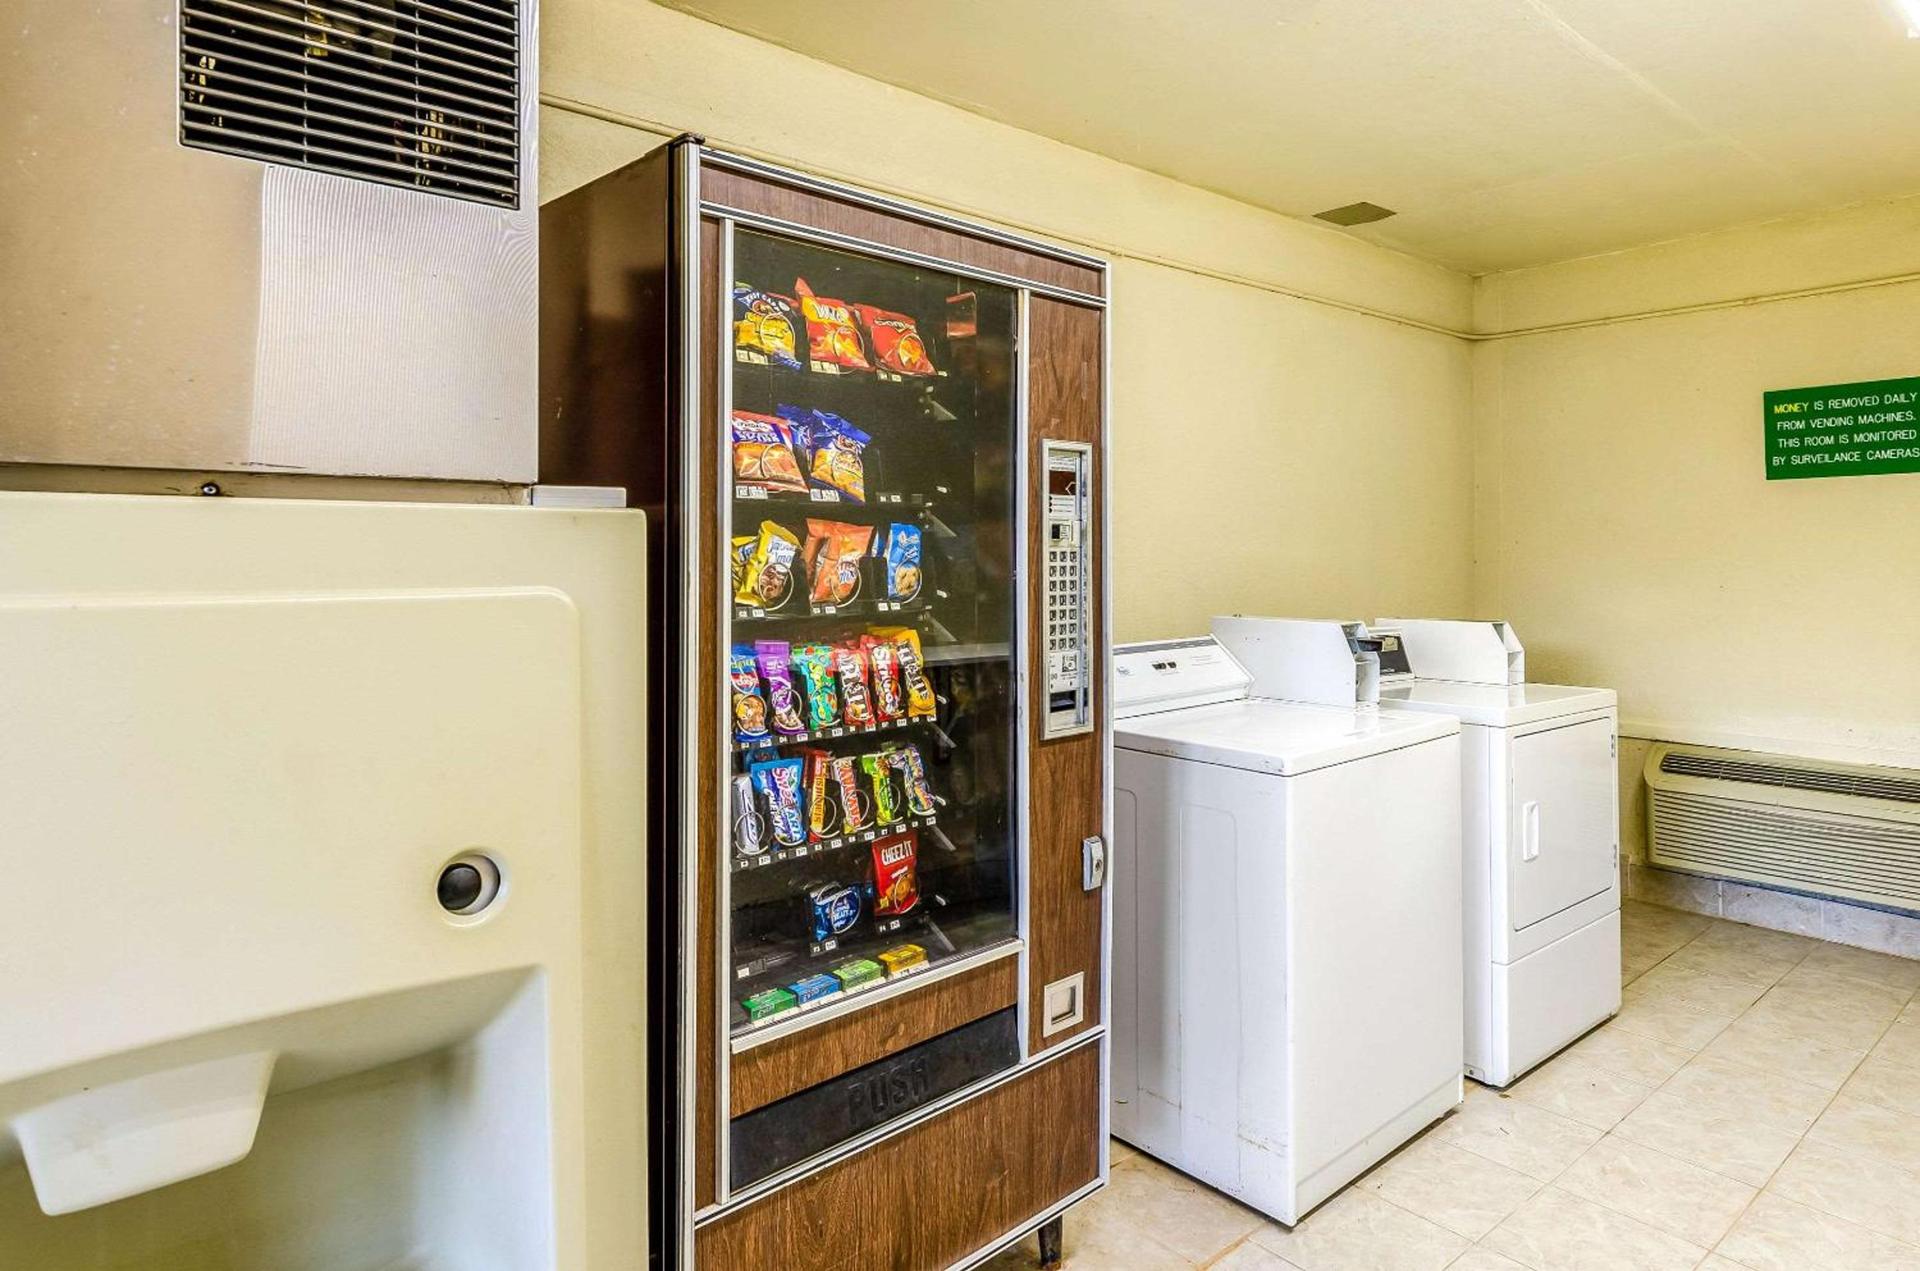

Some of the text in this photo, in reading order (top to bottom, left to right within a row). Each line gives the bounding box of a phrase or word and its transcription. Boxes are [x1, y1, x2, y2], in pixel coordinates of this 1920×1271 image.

[1774, 392, 1918, 414] MONEY IS REMOVED DAILY
[1777, 410, 1917, 431] FROM VENDING MACHINES.
[1777, 429, 1917, 448] THIS ROOM IS MONITORED
[1772, 447, 1920, 466] BY SURVEILANCE CAMERAS
[848, 1056, 929, 1125] PUSH
